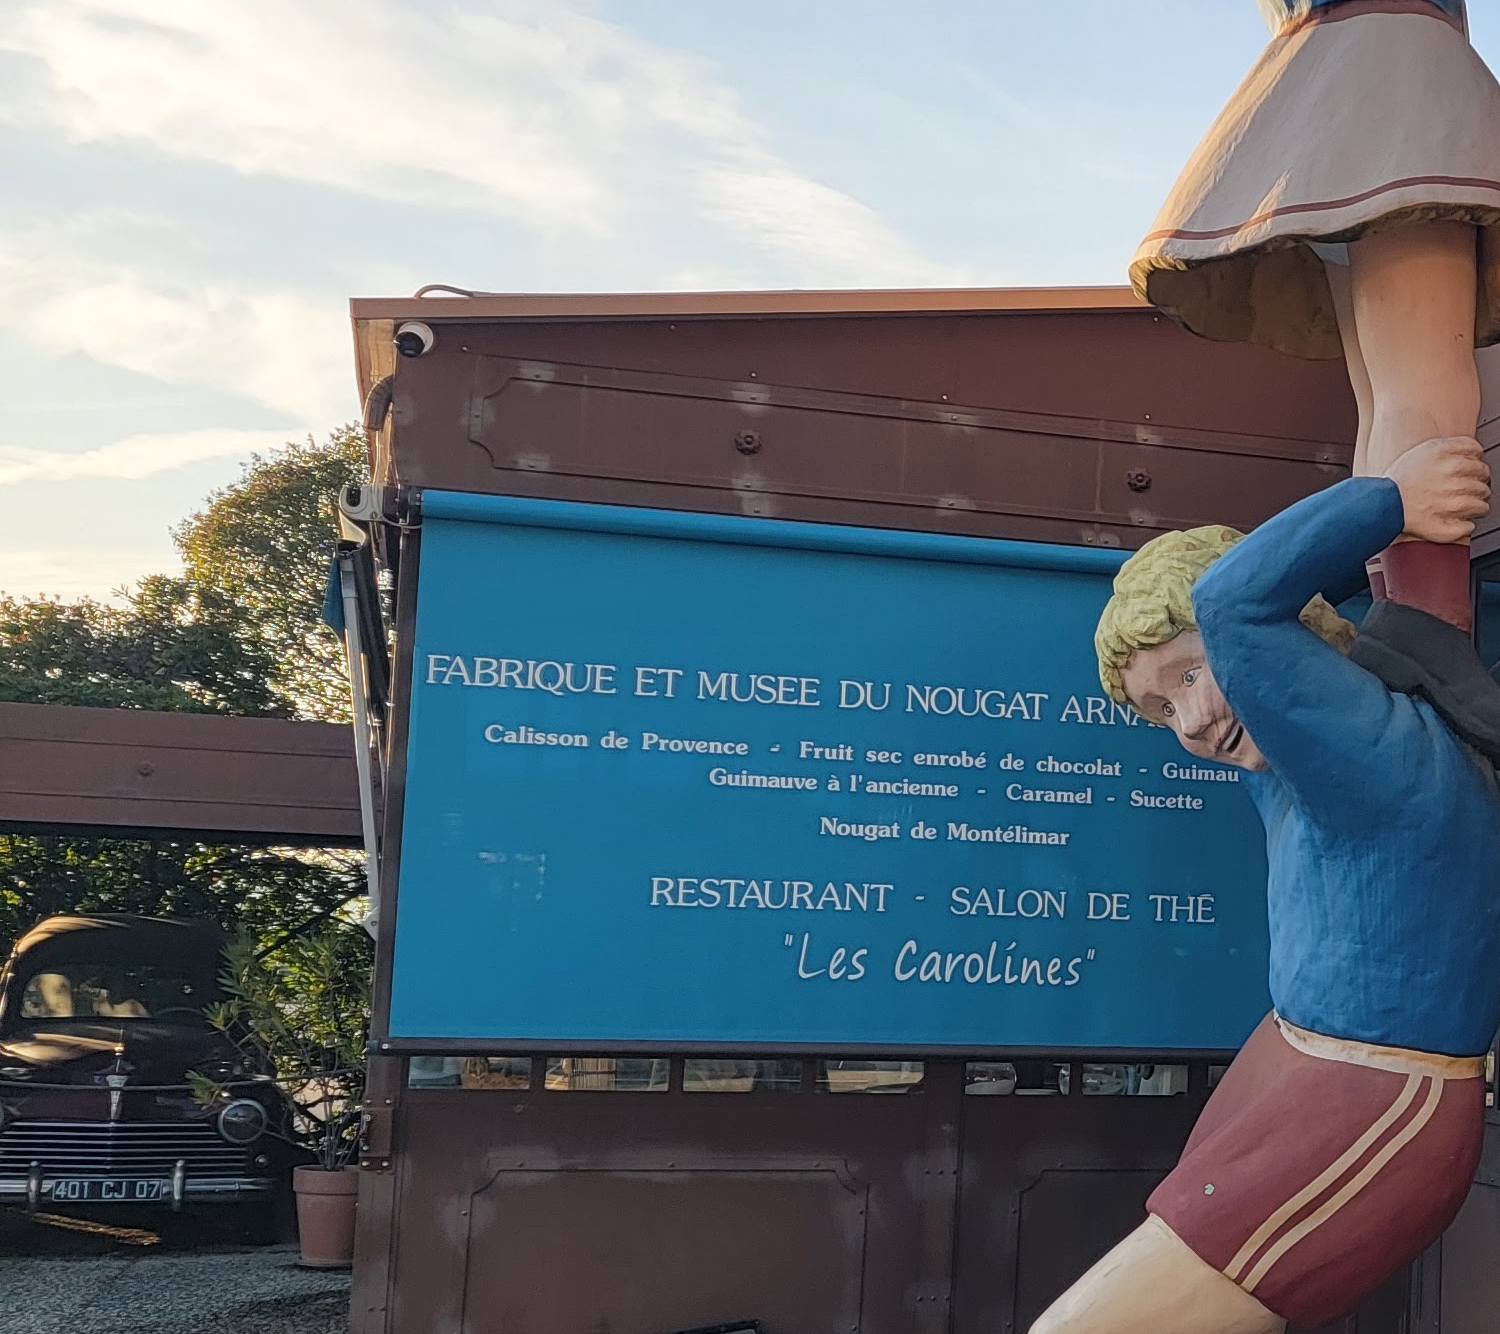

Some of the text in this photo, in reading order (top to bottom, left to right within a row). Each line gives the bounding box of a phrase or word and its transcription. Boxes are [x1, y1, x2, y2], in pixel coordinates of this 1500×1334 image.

[425, 654, 1167, 728] FABRIQUE ET MUSEE DU NOUGAT ARN
[484, 724, 589, 747] Calisson
[600, 730, 629, 750] de
[641, 732, 749, 756] Provence
[799, 740, 854, 761] Fruit
[865, 750, 902, 764] sec
[913, 750, 987, 769] enrobé
[999, 752, 1025, 771] de
[1035, 755, 1122, 777] chocolat
[709, 767, 818, 790] Guimauve
[827, 774, 841, 792] à
[849, 774, 959, 797] l'ancienne
[1006, 783, 1093, 804] Caramel
[1129, 789, 1203, 810] Sucette
[819, 816, 1070, 845] Nougat de Montélimar
[649, 877, 894, 912] RESTAURANT
[949, 886, 1067, 918] SALON
[1087, 892, 1130, 921] DE
[784, 932, 868, 981] "Les
[55, 1180, 160, 1199] 401 CJ 07
